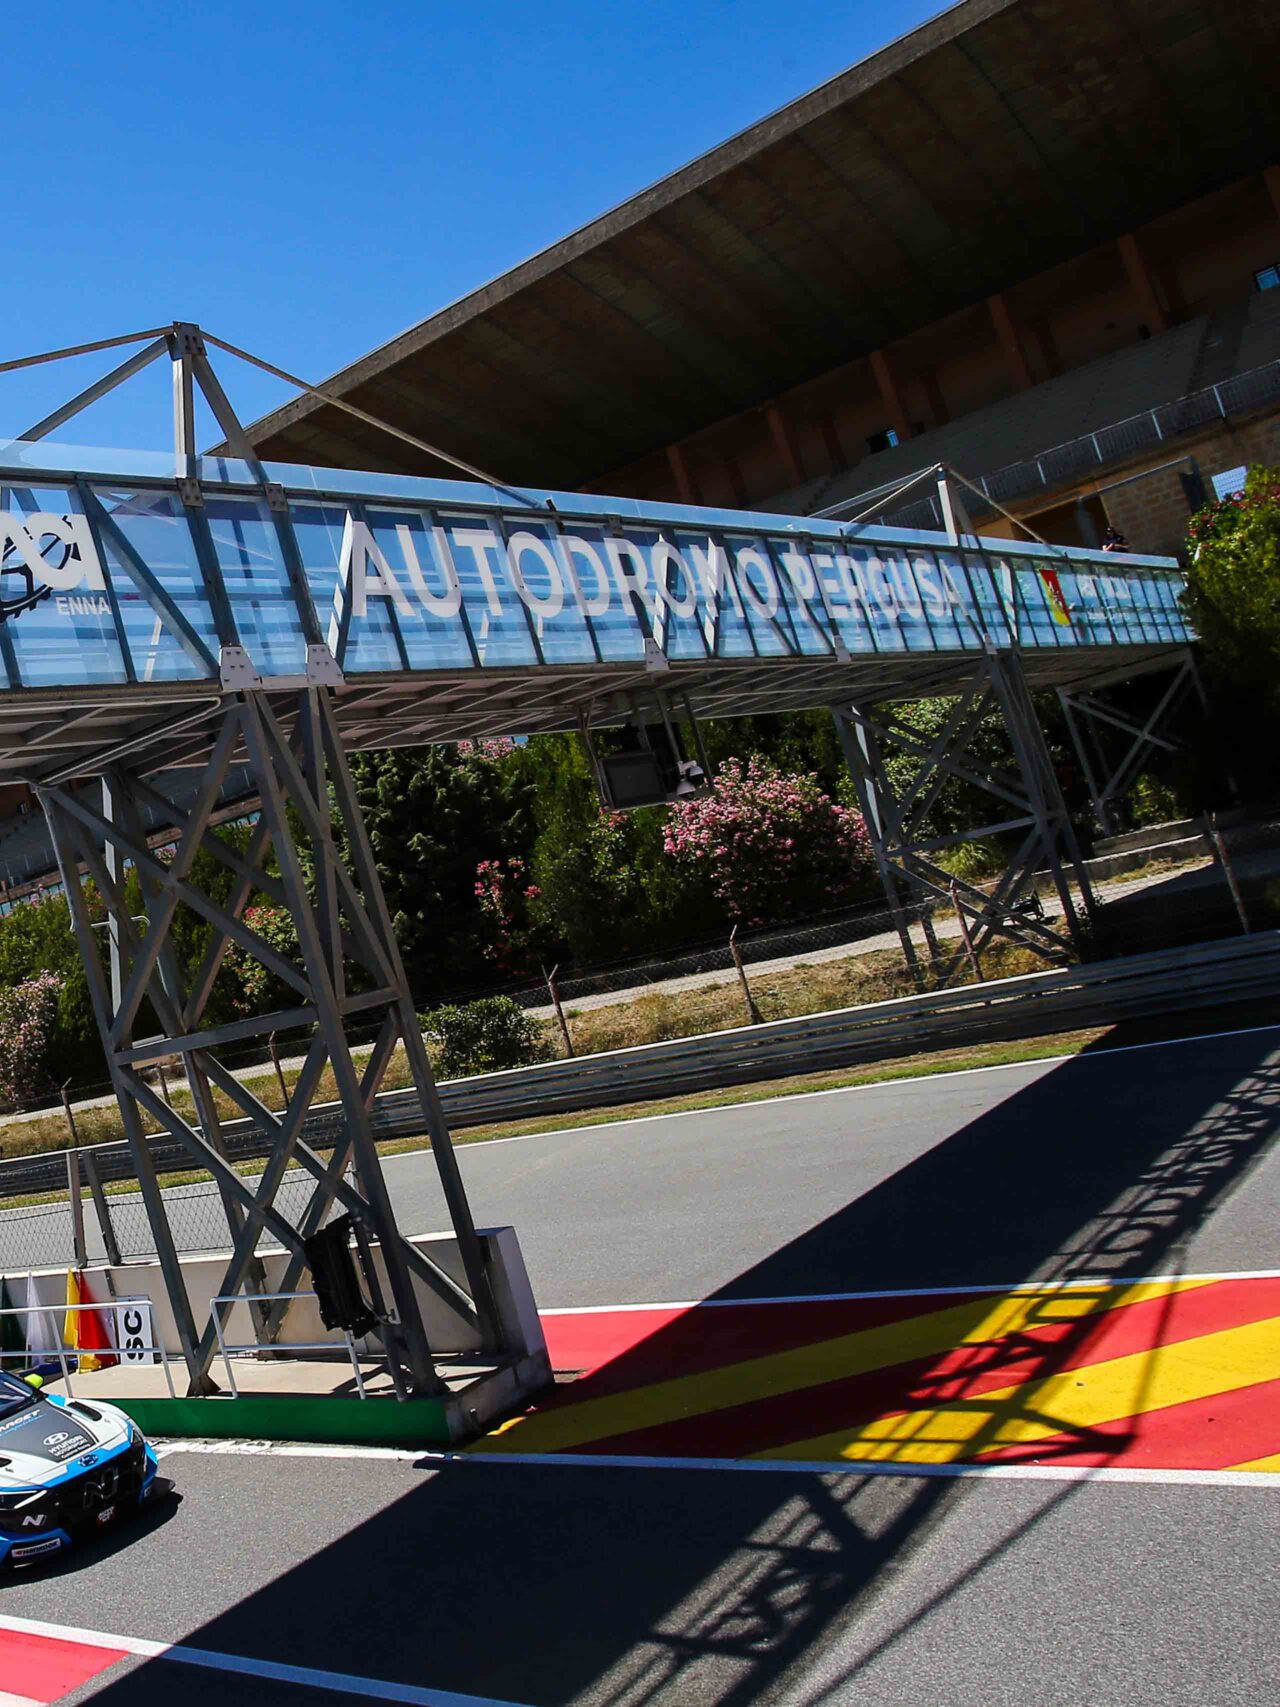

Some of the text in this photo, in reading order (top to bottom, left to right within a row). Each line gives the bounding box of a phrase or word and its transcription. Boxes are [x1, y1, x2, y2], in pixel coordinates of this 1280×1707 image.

[351, 520, 969, 620] AUTODROMO PERGUSA
[55, 597, 113, 616] ENNA
[124, 1310, 144, 1360] SC
[48, 1435, 84, 1454] HYUNDAI
